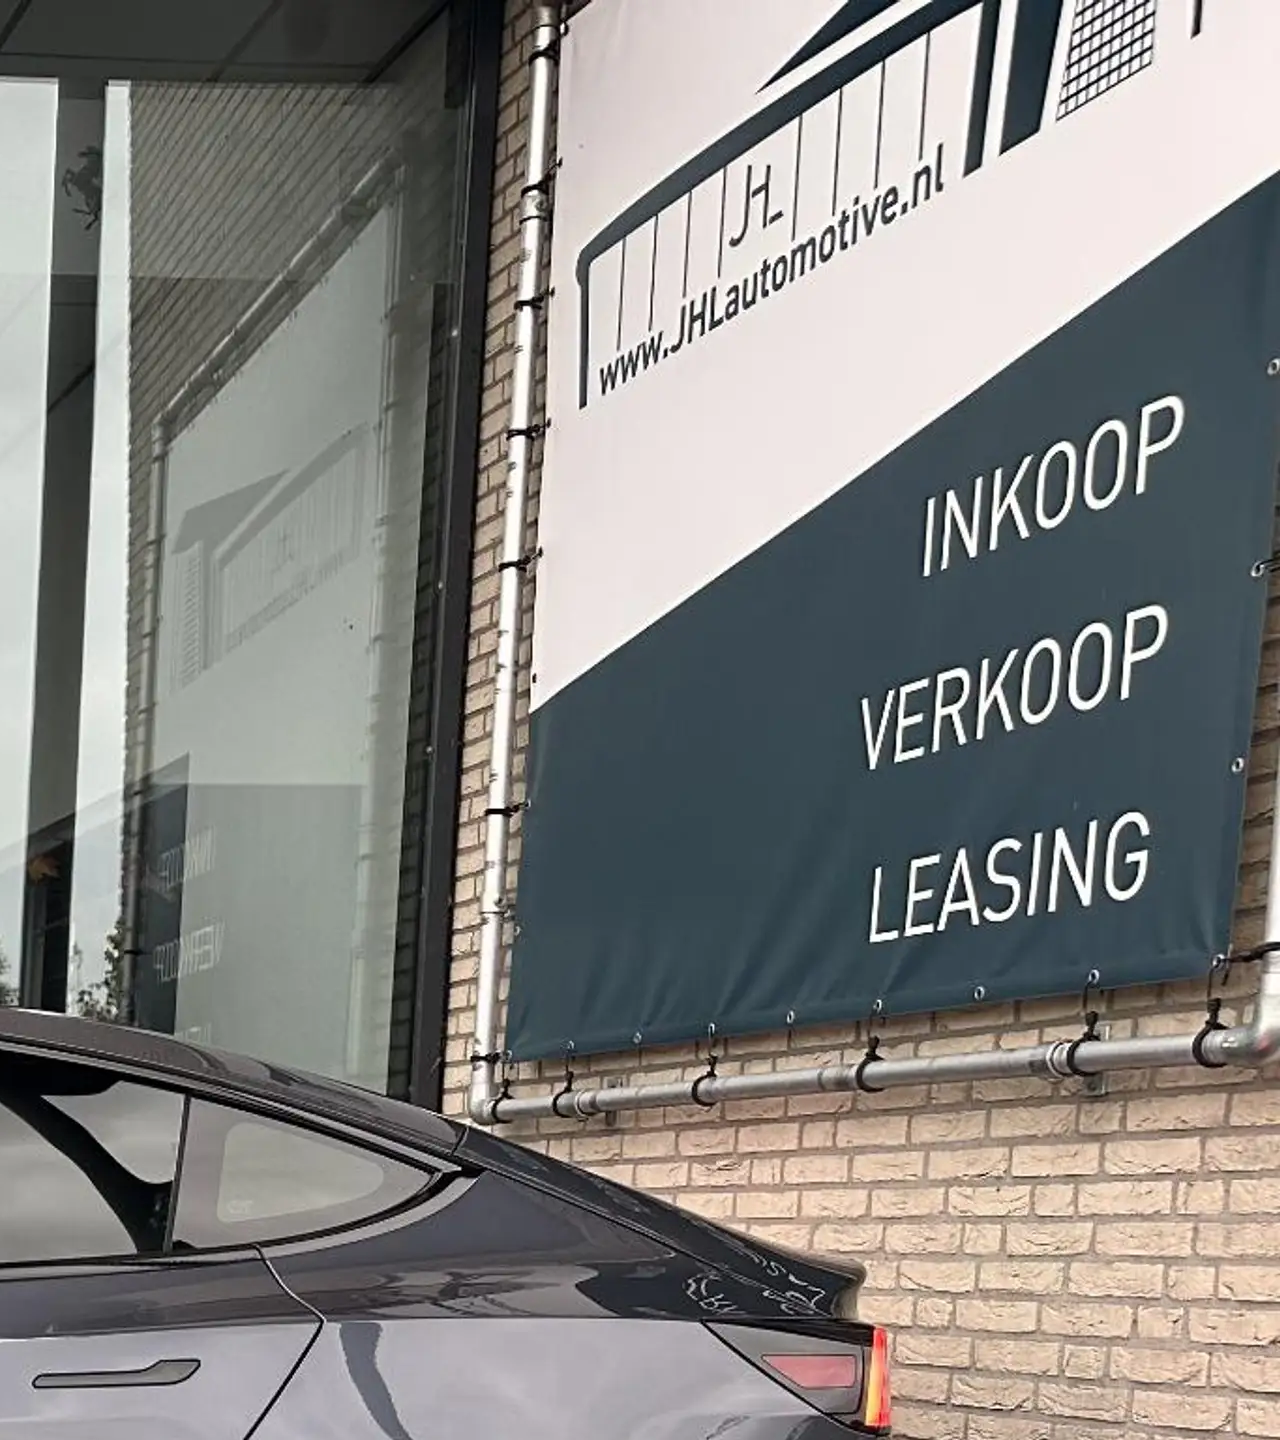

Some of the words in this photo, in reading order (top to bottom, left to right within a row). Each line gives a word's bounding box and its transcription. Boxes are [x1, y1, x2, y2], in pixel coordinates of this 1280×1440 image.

[598, 144, 945, 396] www.JHLautomotive.nl
[922, 395, 1185, 577] INKOOP
[861, 605, 1169, 770] VERKOOP
[869, 812, 1151, 943] LEASING
